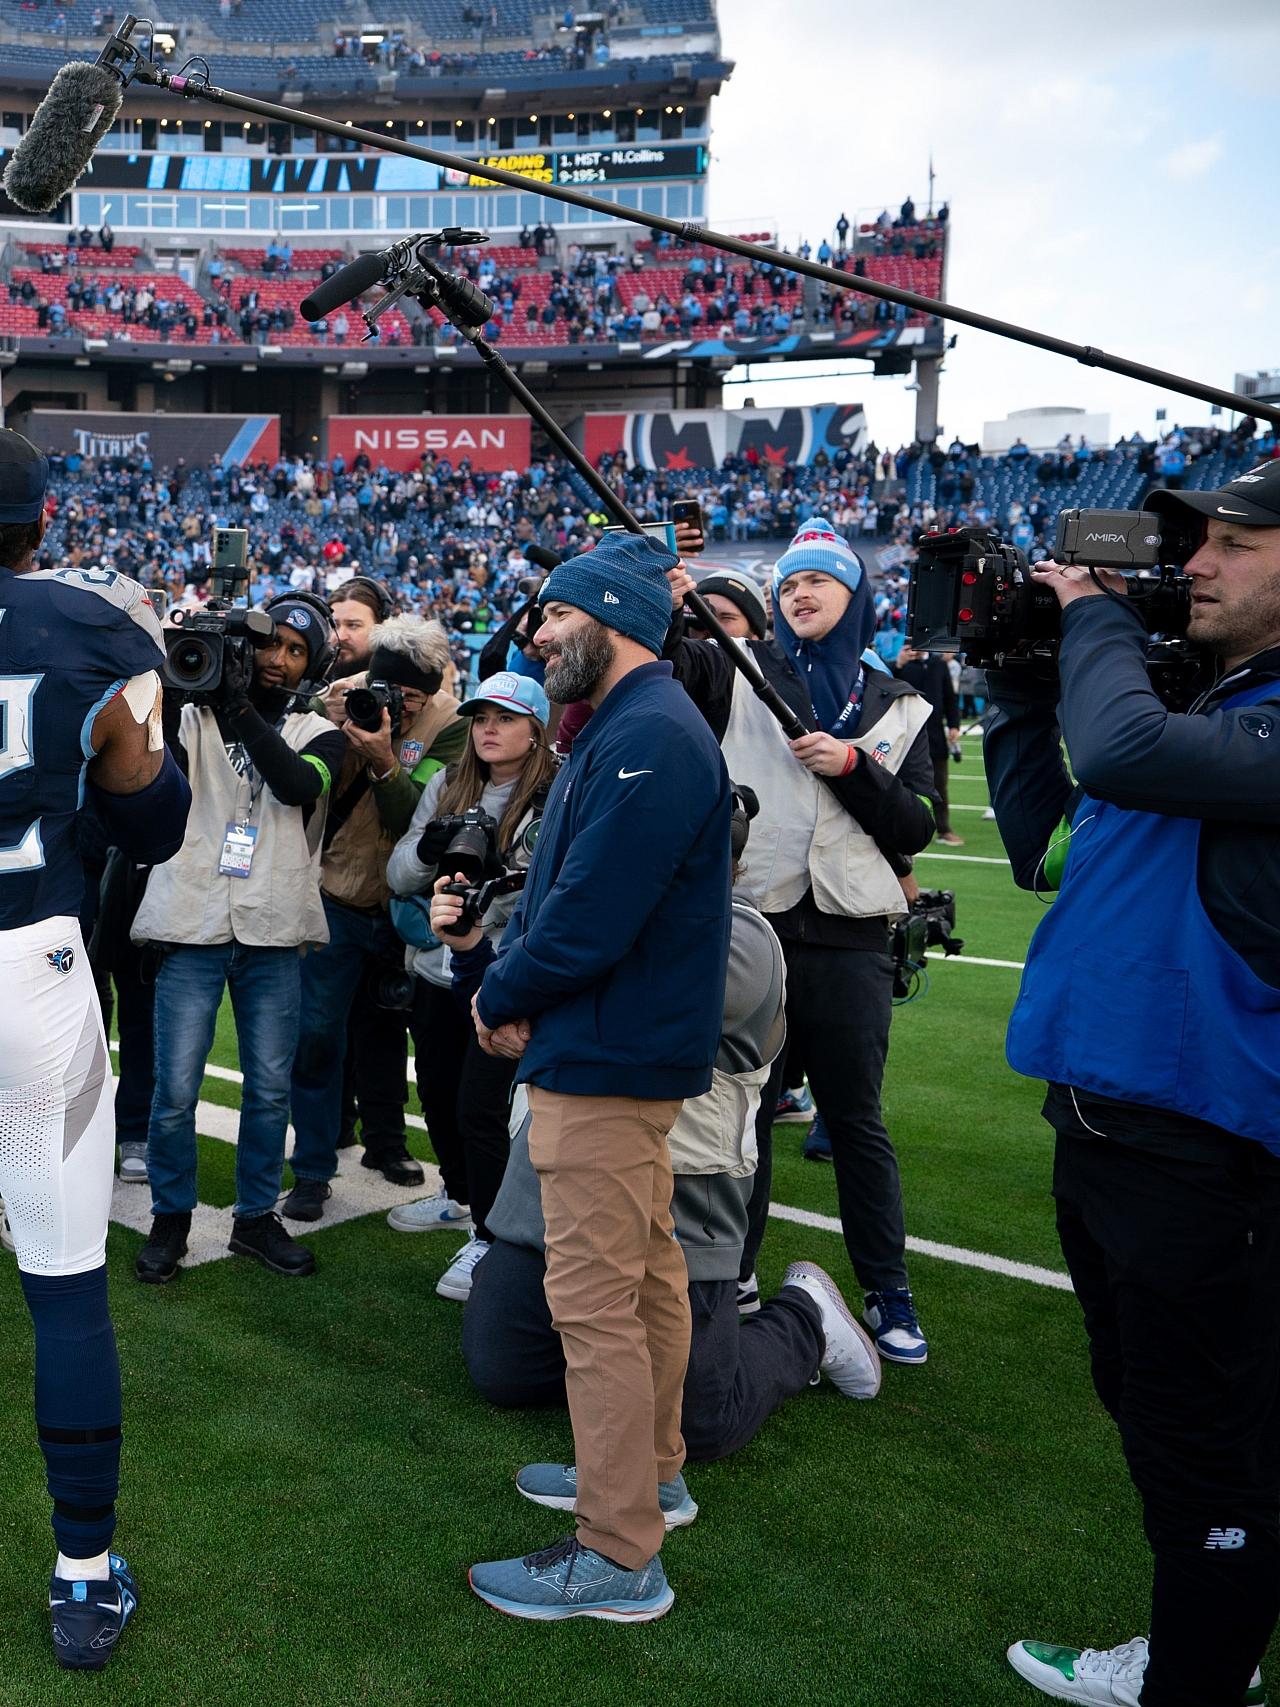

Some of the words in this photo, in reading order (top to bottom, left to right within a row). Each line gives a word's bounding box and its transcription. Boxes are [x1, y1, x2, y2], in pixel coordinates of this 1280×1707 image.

[355, 429, 505, 449] NISSAN
[1085, 533, 1126, 543] AMIRA
[402, 750, 418, 761] NFL
[1203, 1528, 1246, 1549] NB
